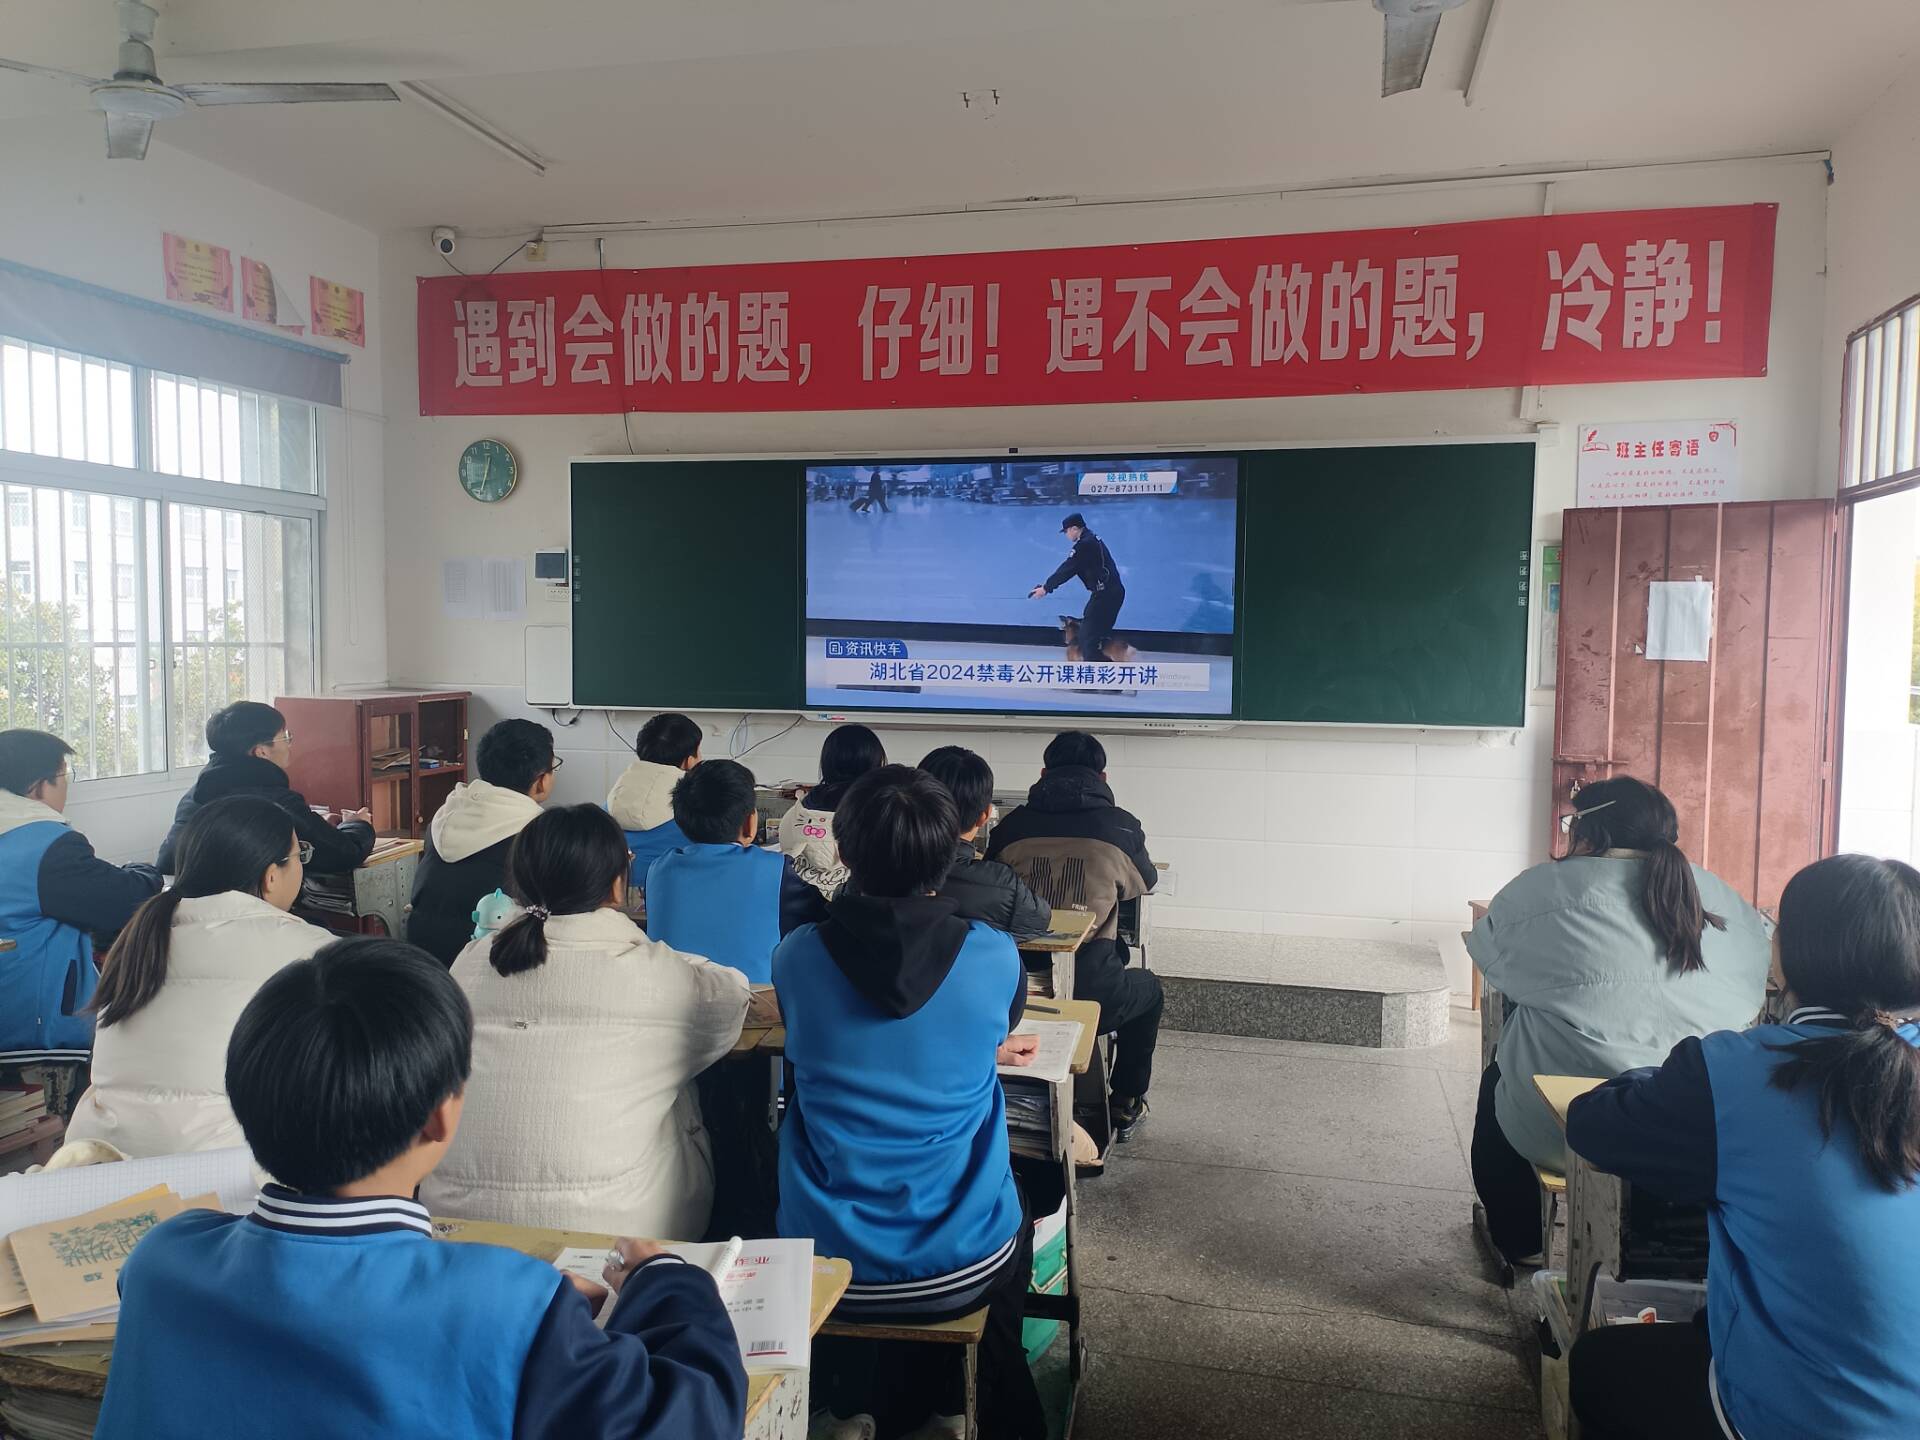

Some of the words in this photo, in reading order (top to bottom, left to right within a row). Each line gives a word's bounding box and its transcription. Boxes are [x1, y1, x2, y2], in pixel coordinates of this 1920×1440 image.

[454, 291, 811, 388] 遇到会做的题，
[858, 282, 1000, 381] 仔细！
[1045, 254, 1484, 374] 遇不会做的题，
[1541, 239, 1726, 351] 冷静！
[1616, 439, 1700, 459] 班主任寄语
[1090, 484, 1164, 494] 027-87311111
[845, 641, 901, 657] 资讯快车
[869, 662, 1159, 686] 湖北省2024禁毒公开课精彩开讲
